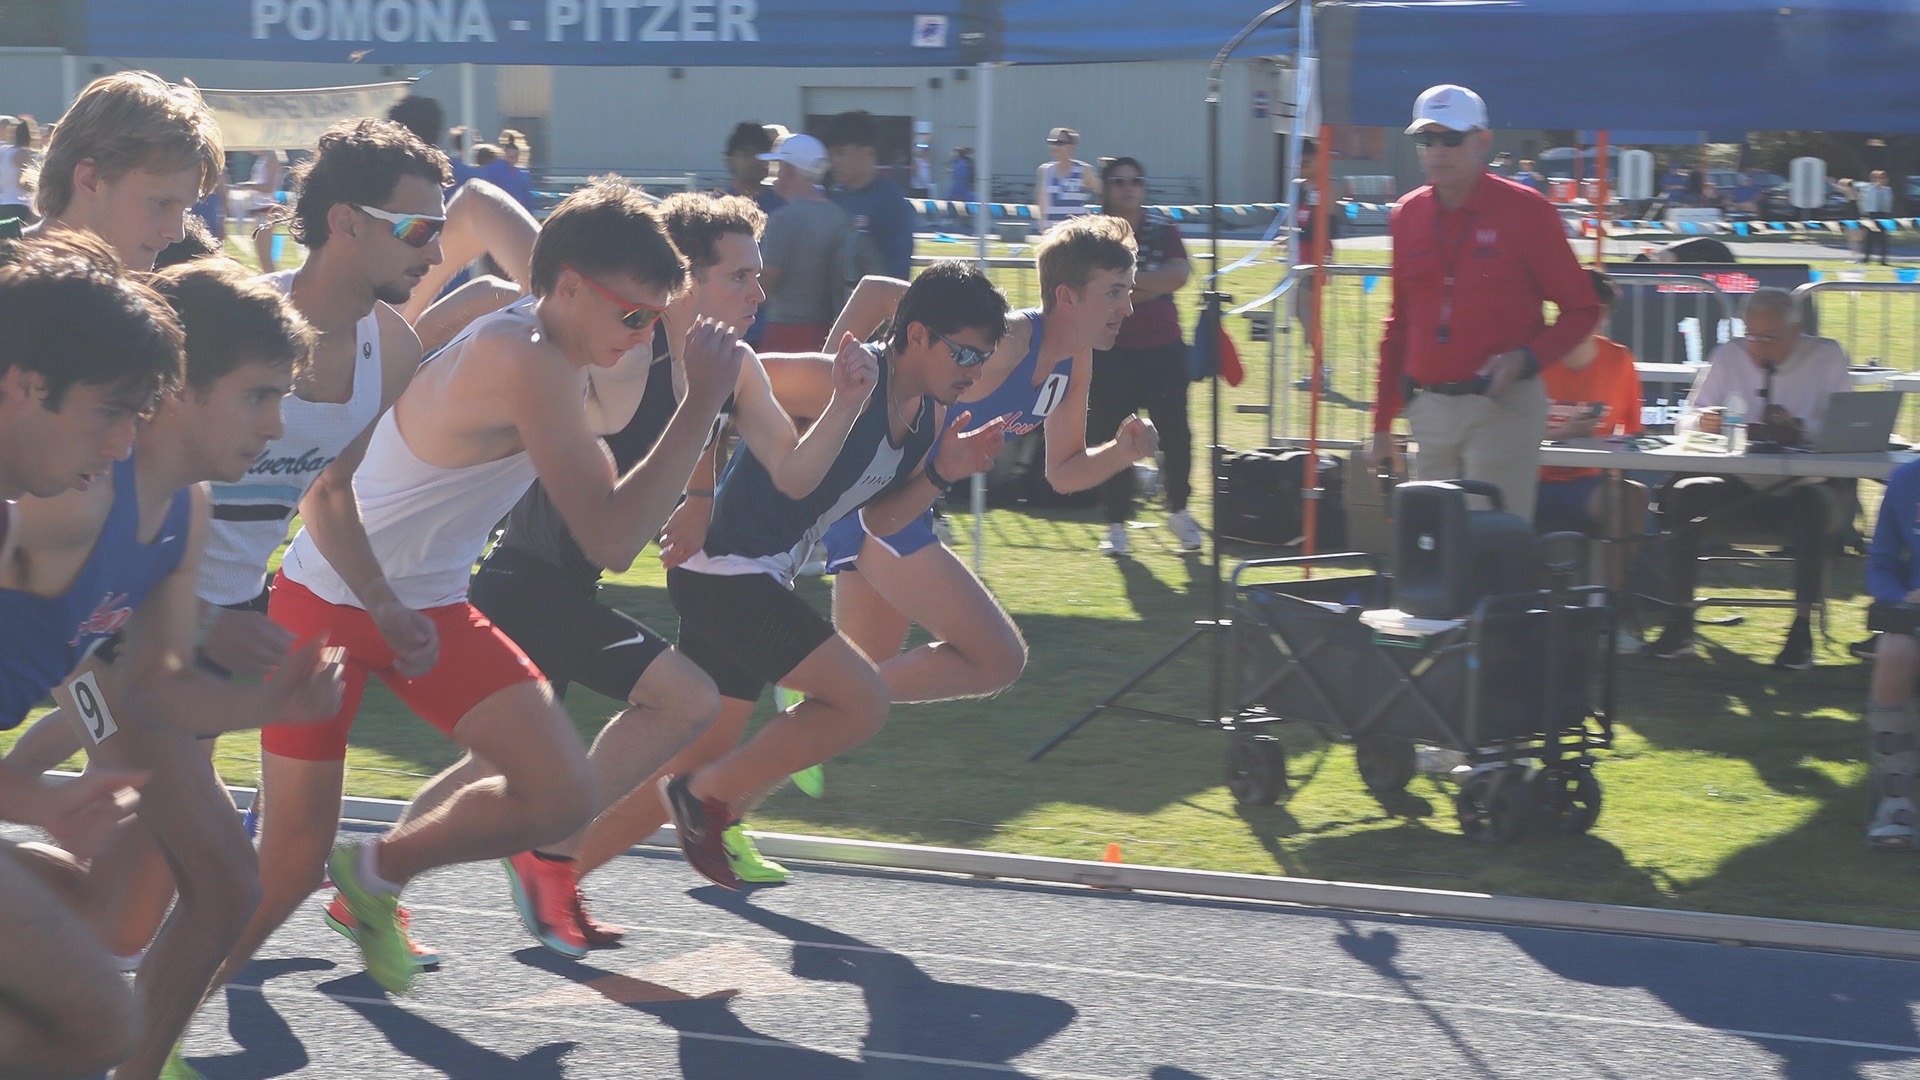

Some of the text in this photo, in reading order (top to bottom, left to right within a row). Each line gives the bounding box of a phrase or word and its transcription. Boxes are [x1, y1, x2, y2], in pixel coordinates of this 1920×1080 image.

[250, 0, 498, 43] POMONA
[545, 0, 761, 42] PITZER
[1044, 376, 1060, 415] 1
[75, 681, 105, 739] 9
